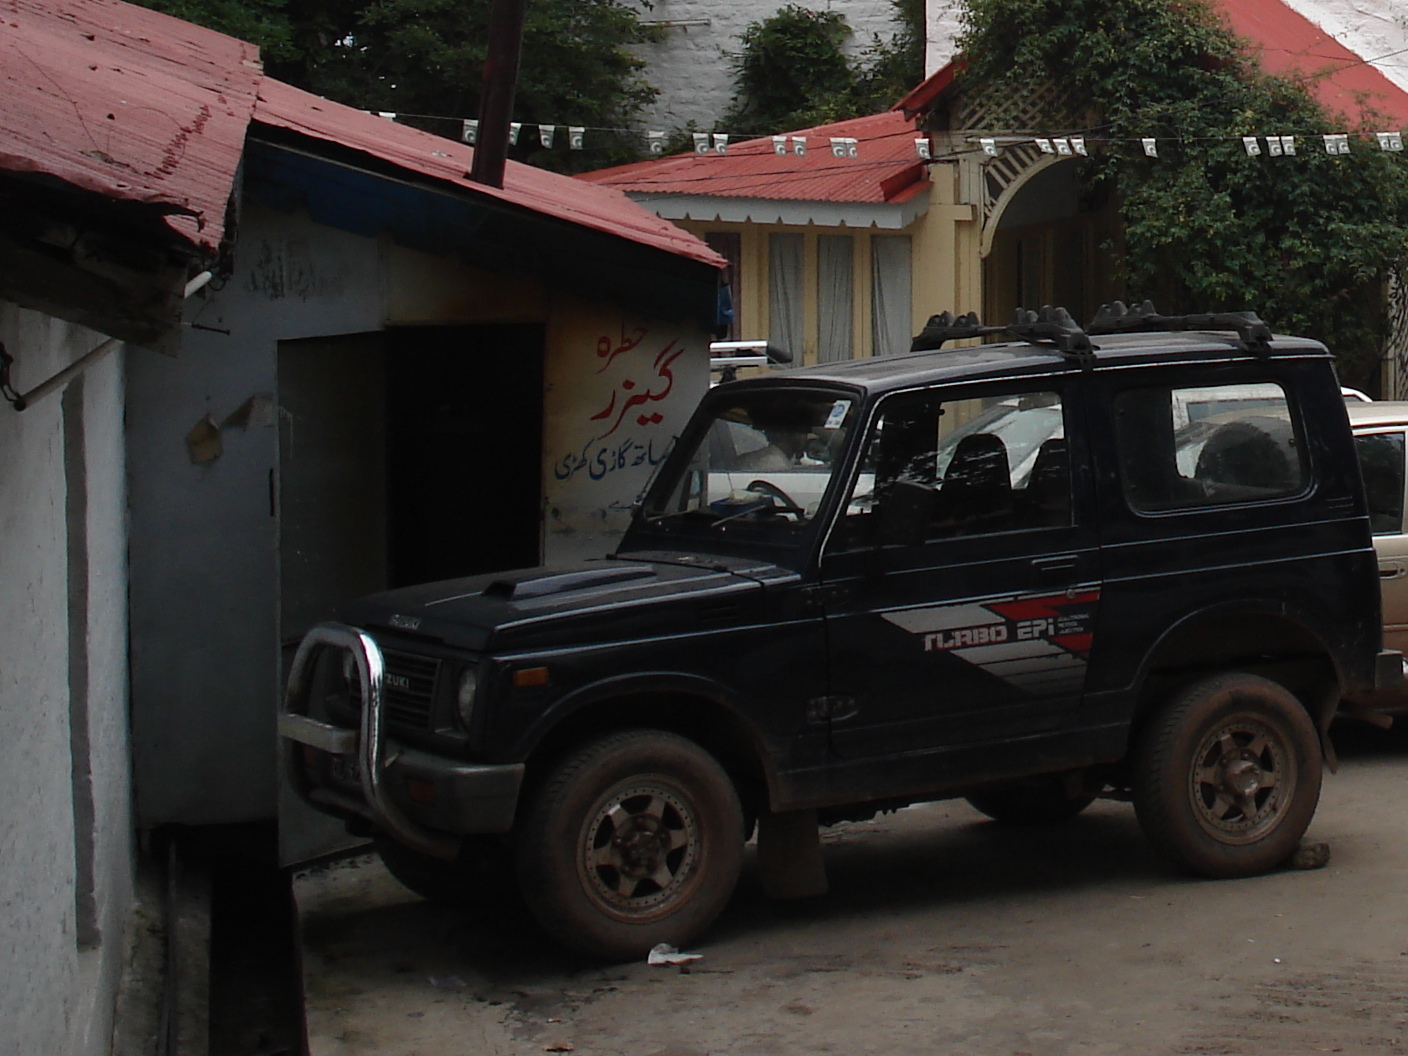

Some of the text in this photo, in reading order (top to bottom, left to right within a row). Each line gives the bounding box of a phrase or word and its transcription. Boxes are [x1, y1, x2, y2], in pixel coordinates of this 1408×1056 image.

[590, 337, 685, 441] گیزر
[554, 437, 595, 482] کھڑی
[589, 438, 634, 481] گاڑی
[924, 625, 1008, 652] TURBO
